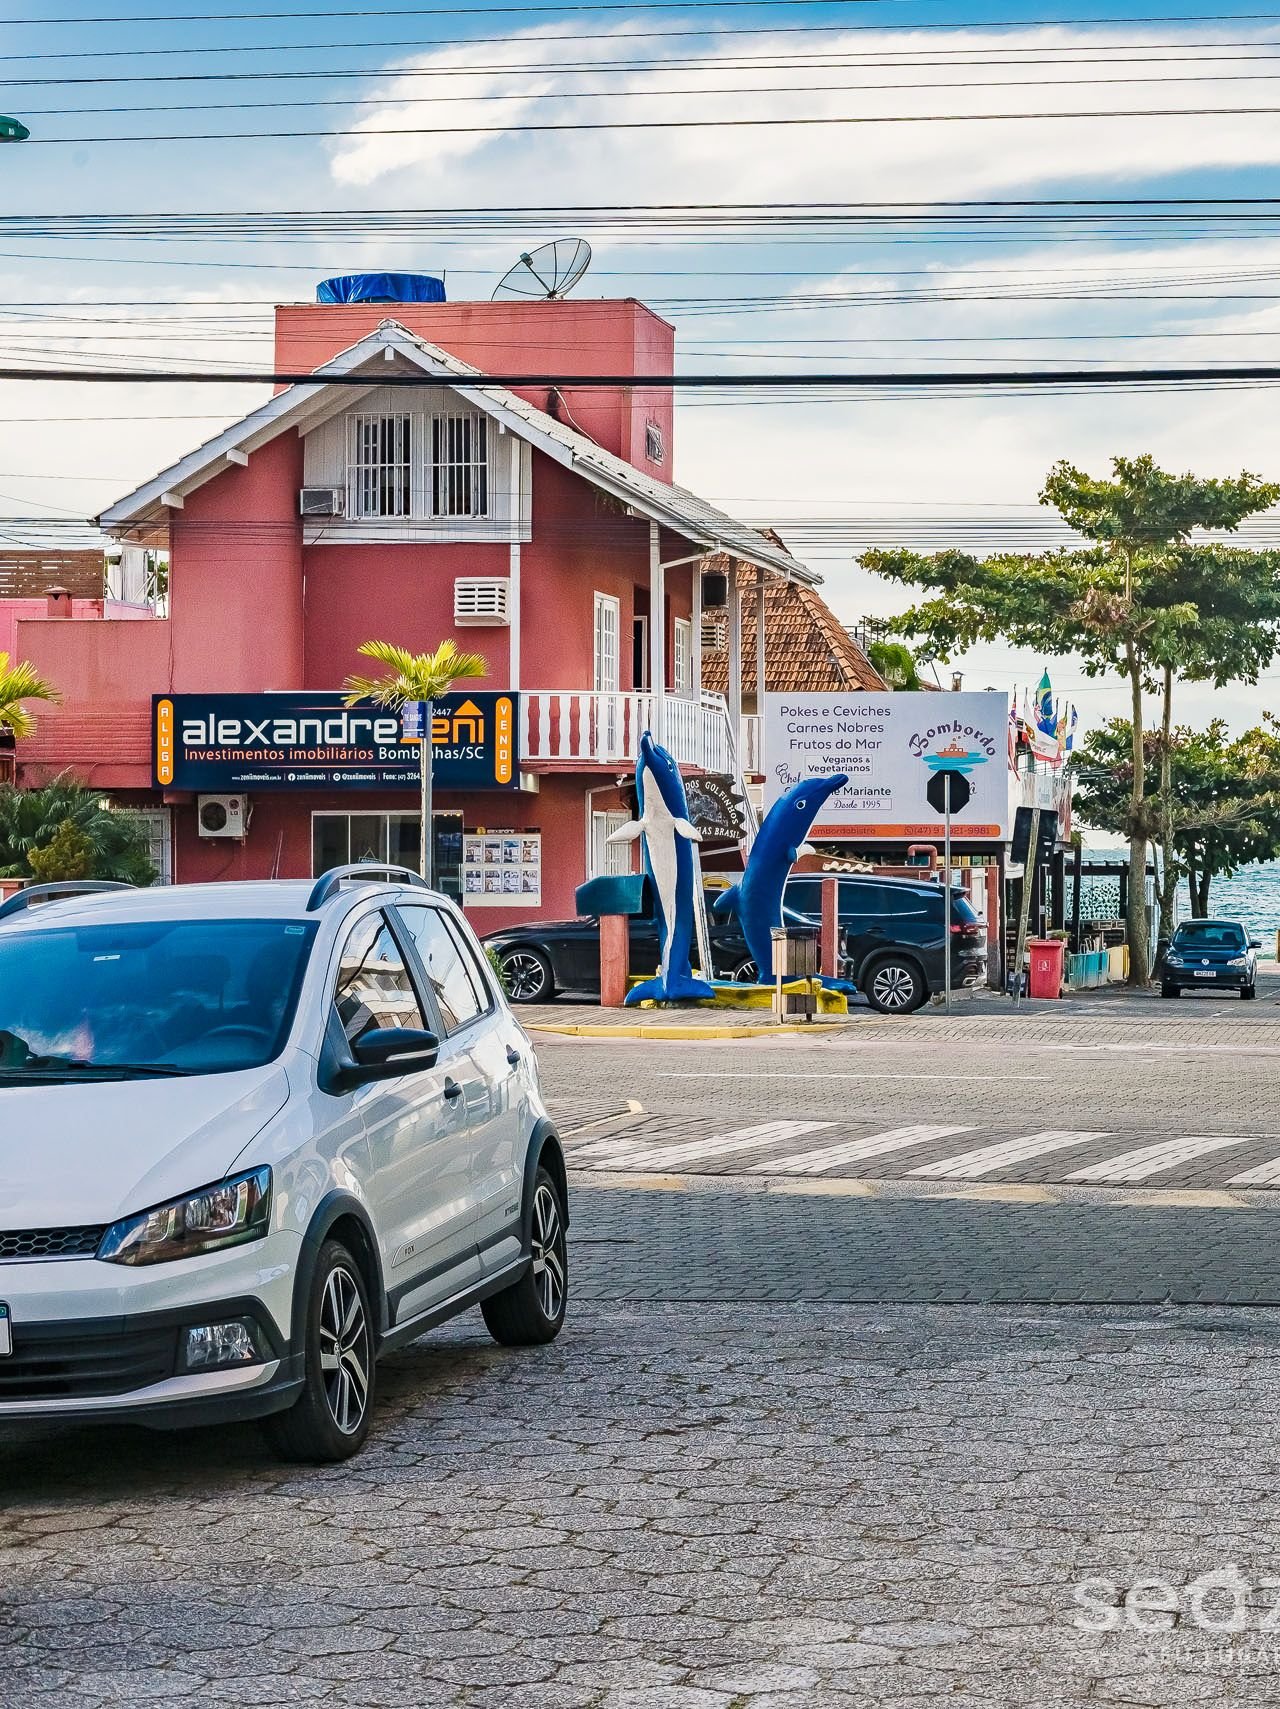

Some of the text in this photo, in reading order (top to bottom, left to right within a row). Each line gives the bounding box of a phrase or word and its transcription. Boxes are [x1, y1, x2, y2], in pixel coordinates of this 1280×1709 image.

[780, 706, 891, 717] Pokes e Ceviches
[787, 722, 885, 733] Carnes Nobres
[160, 707, 169, 777] ALUGA
[499, 705, 508, 775] VENDE
[789, 738, 883, 750] Frutos do Mar
[908, 719, 996, 758] Bombordo
[184, 746, 485, 761] Investimentos imobiliários Bombhas/SC
[822, 756, 863, 764] Veganos
[808, 764, 871, 774] Vegetarianos
[843, 786, 892, 796] Mariante
[685, 779, 739, 825] DOS GOLFINHOS
[862, 800, 881, 809] 1995
[715, 827, 741, 839] BRASIL
[809, 827, 876, 835] ombordobistro
